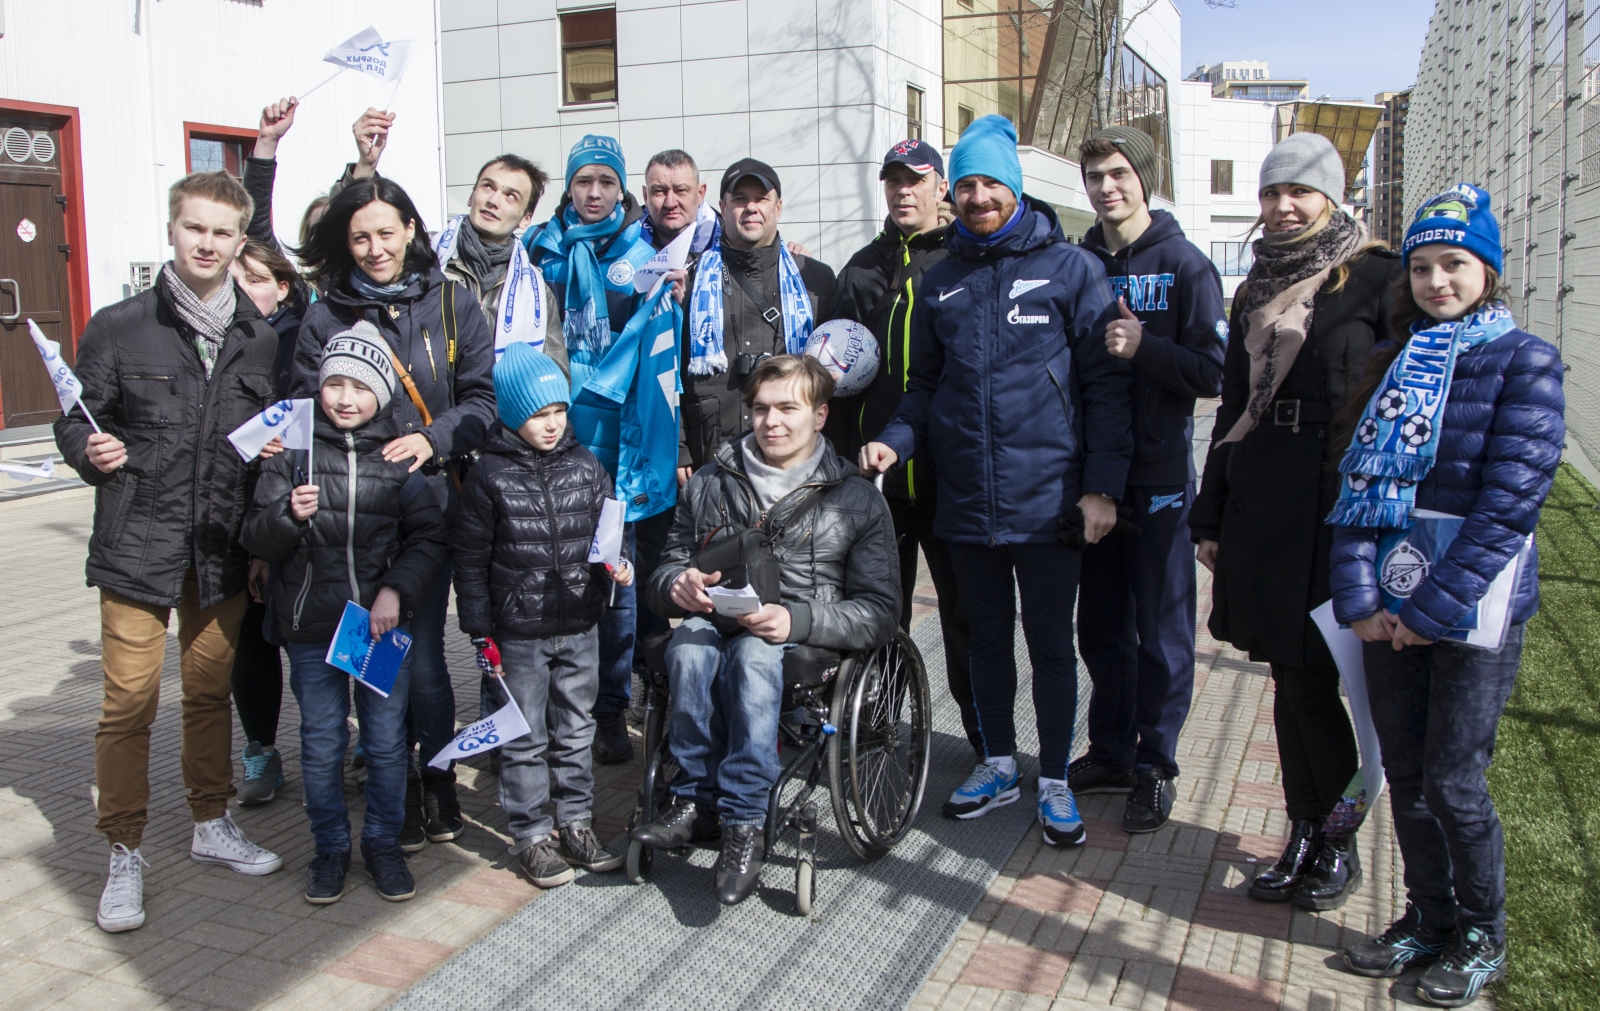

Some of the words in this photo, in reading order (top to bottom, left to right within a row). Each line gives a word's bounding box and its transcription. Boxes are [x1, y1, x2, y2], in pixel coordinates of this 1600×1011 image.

[571, 138, 624, 159] ZENI
[1405, 228, 1466, 250] STUDENT
[1108, 273, 1175, 311] ENIT
